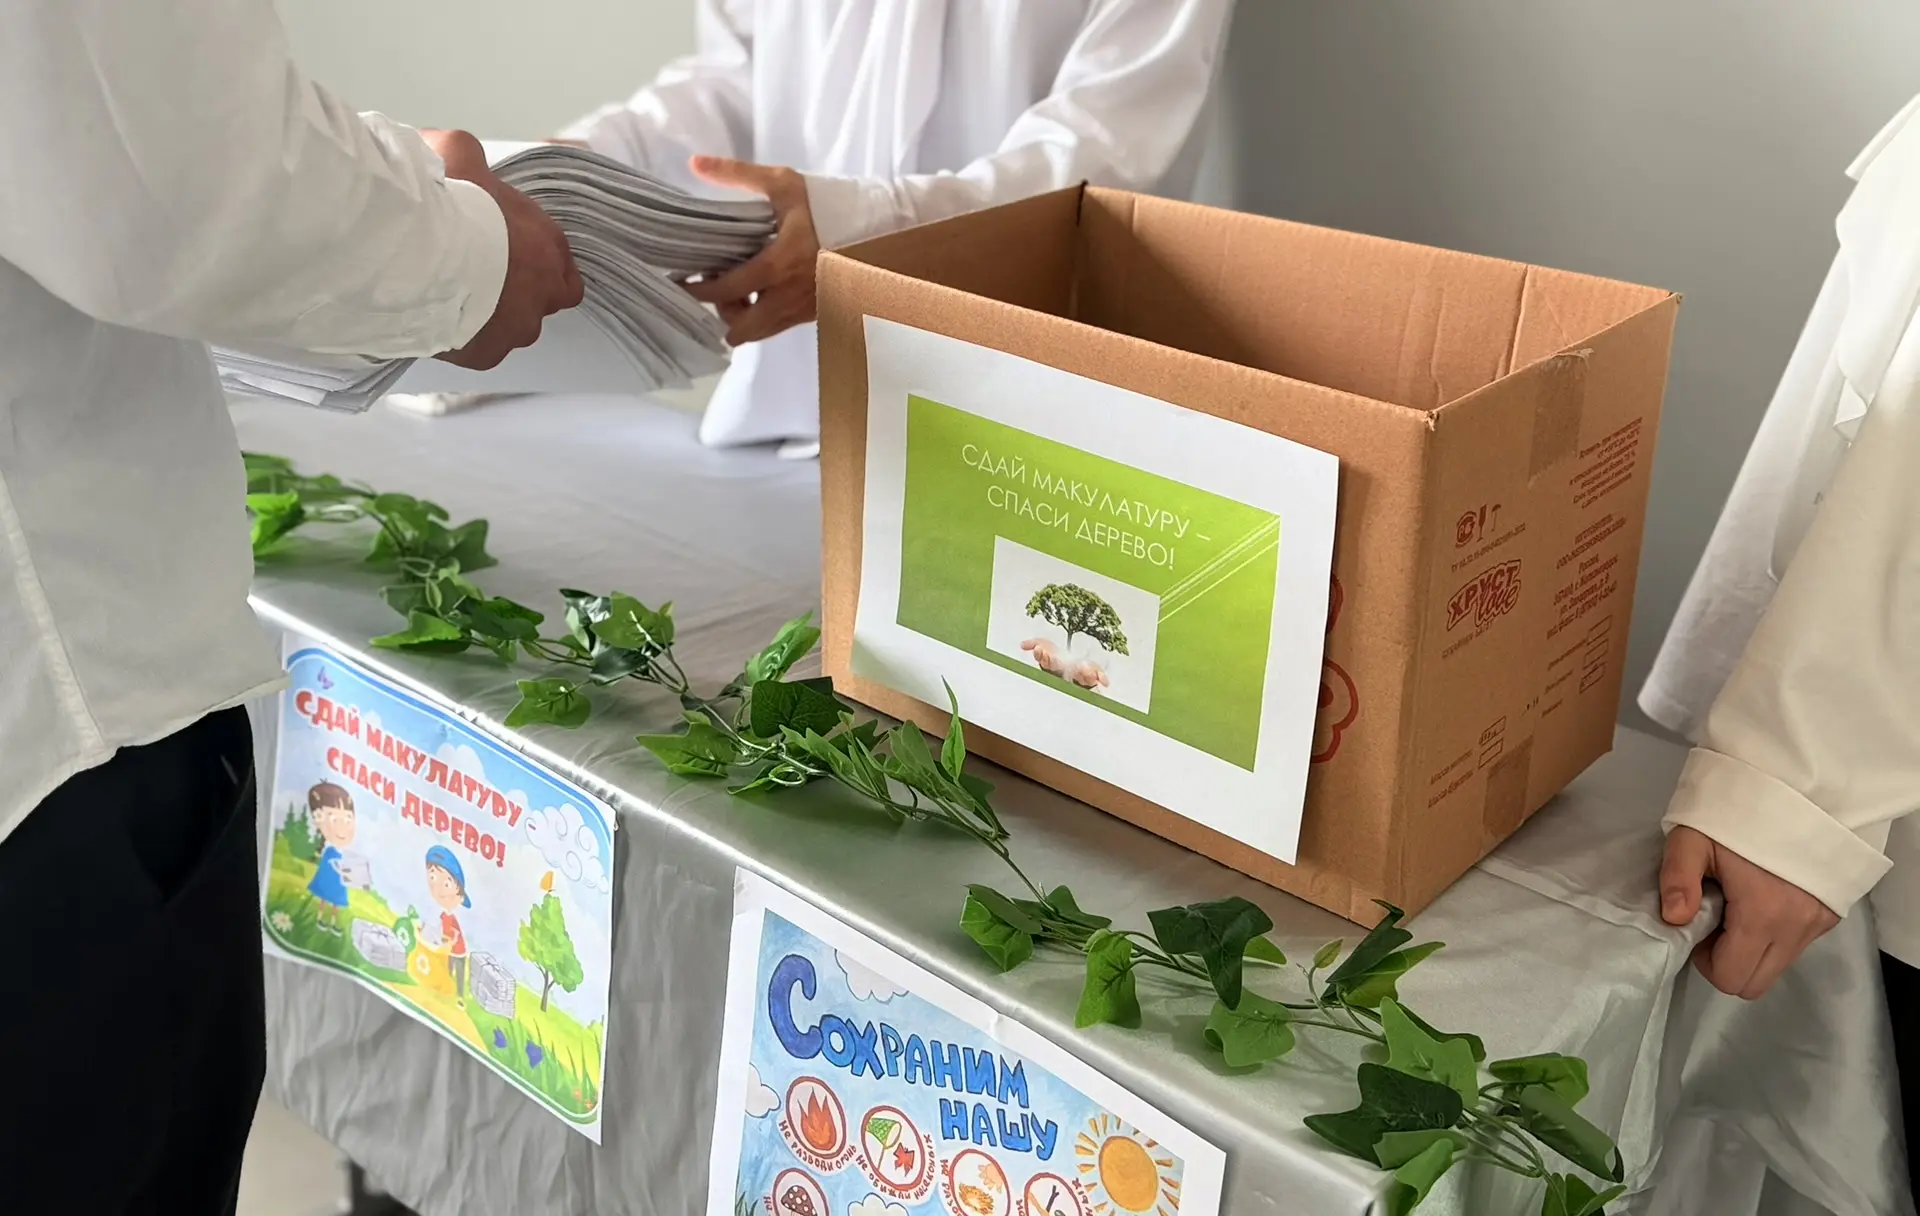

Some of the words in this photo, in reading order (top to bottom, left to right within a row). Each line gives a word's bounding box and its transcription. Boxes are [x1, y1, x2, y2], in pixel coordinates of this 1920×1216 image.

[962, 443, 1026, 484] СДАЙ
[1033, 469, 1190, 538] МАКУЛАТУРУ
[987, 485, 1069, 532] СПАСИ
[1074, 518, 1175, 570] ДЕРЕВО!
[1450, 566, 1518, 625] ХРУСТ
[295, 691, 360, 740] СДАЙ
[366, 723, 522, 828] МАКУЛАТУРУ
[326, 747, 396, 805] СПАСИ
[401, 791, 506, 868] ДЕРЕВО!
[791, 1141, 834, 1172] РАЗВОДИ
[939, 1098, 1058, 1161] НАШУ
